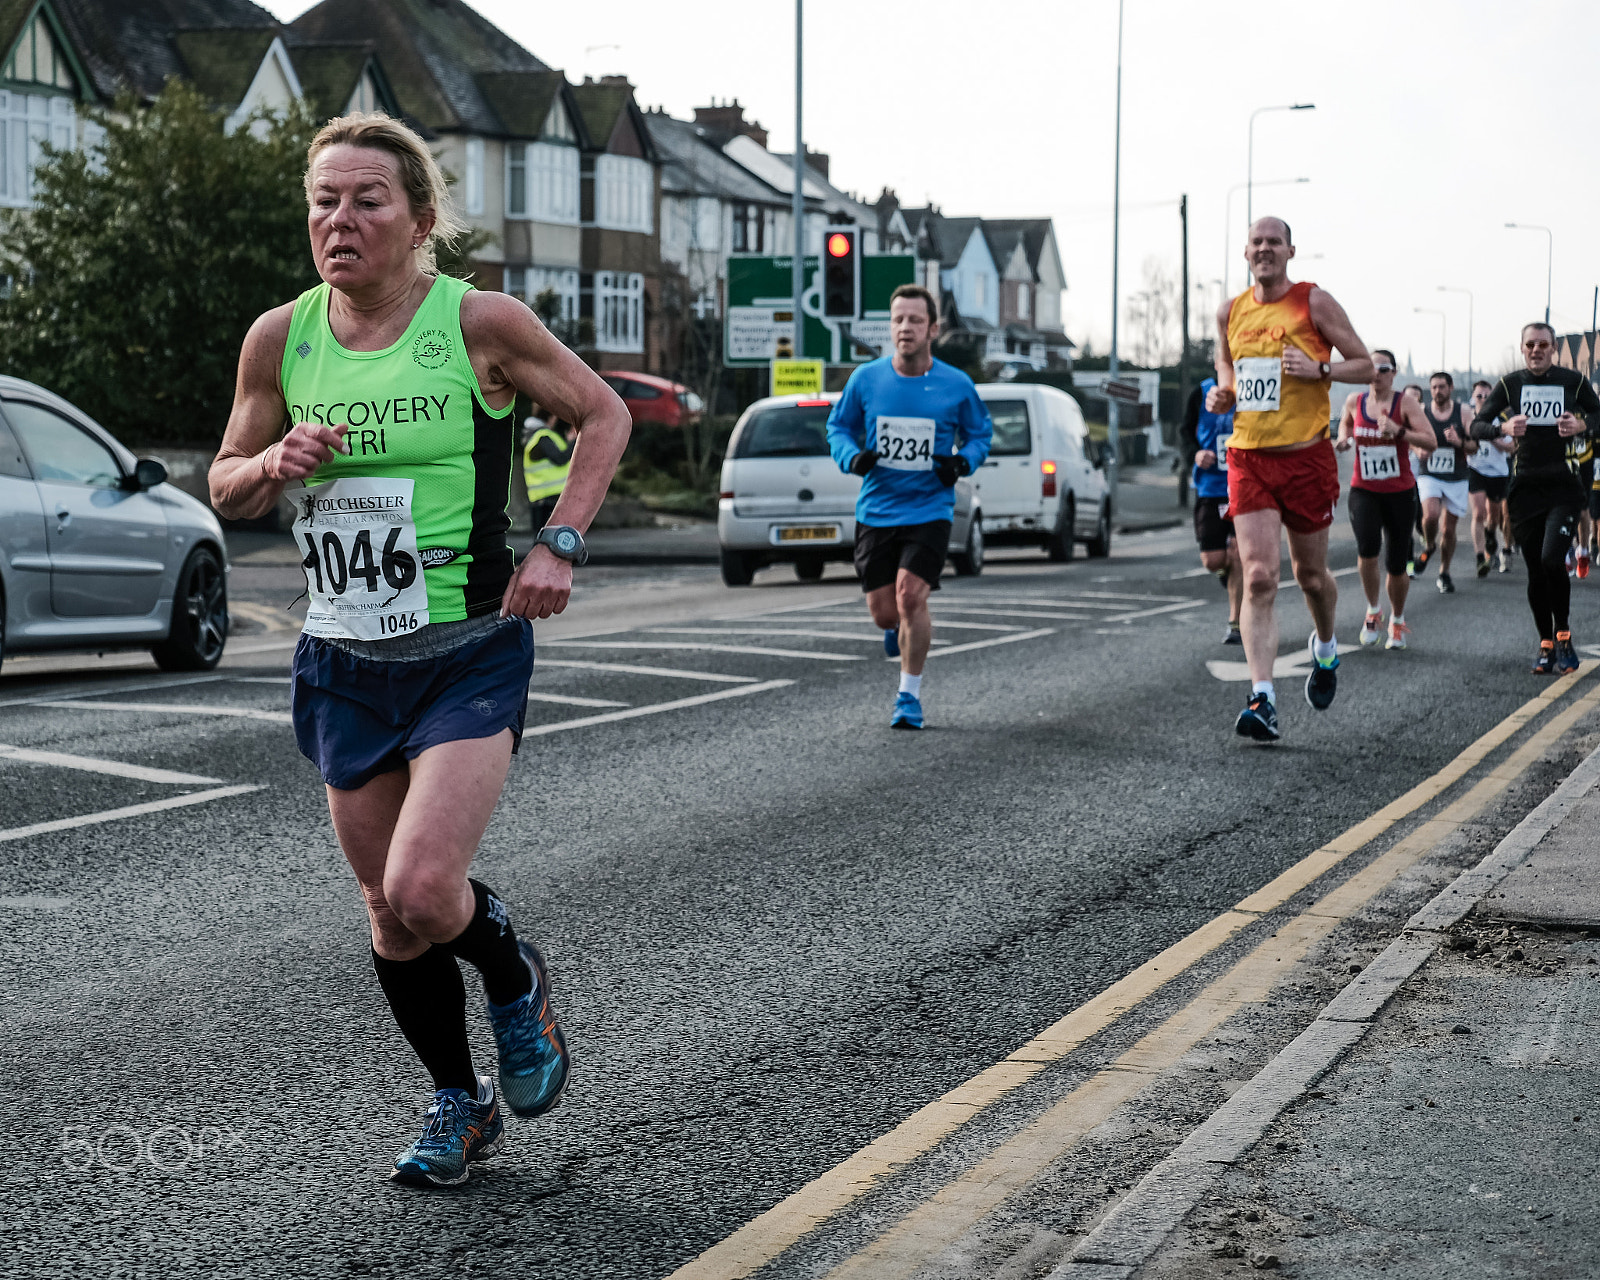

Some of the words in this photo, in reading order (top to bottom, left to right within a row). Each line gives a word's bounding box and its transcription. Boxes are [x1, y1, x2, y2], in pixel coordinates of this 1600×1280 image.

[411, 329, 436, 362] DISCOVERY
[437, 329, 448, 340] TRI
[1237, 378, 1277, 401] 2802
[291, 394, 449, 427] DISCOVERY
[1523, 401, 1562, 418] 2070
[345, 428, 387, 456] TRI
[878, 435, 930, 462] 3234
[1364, 456, 1395, 475] 1141
[317, 495, 405, 512] COLCHESTER
[318, 518, 339, 526] HALF
[343, 513, 404, 525] MARATHON
[303, 527, 416, 595] 1046
[380, 612, 418, 635] 1046
